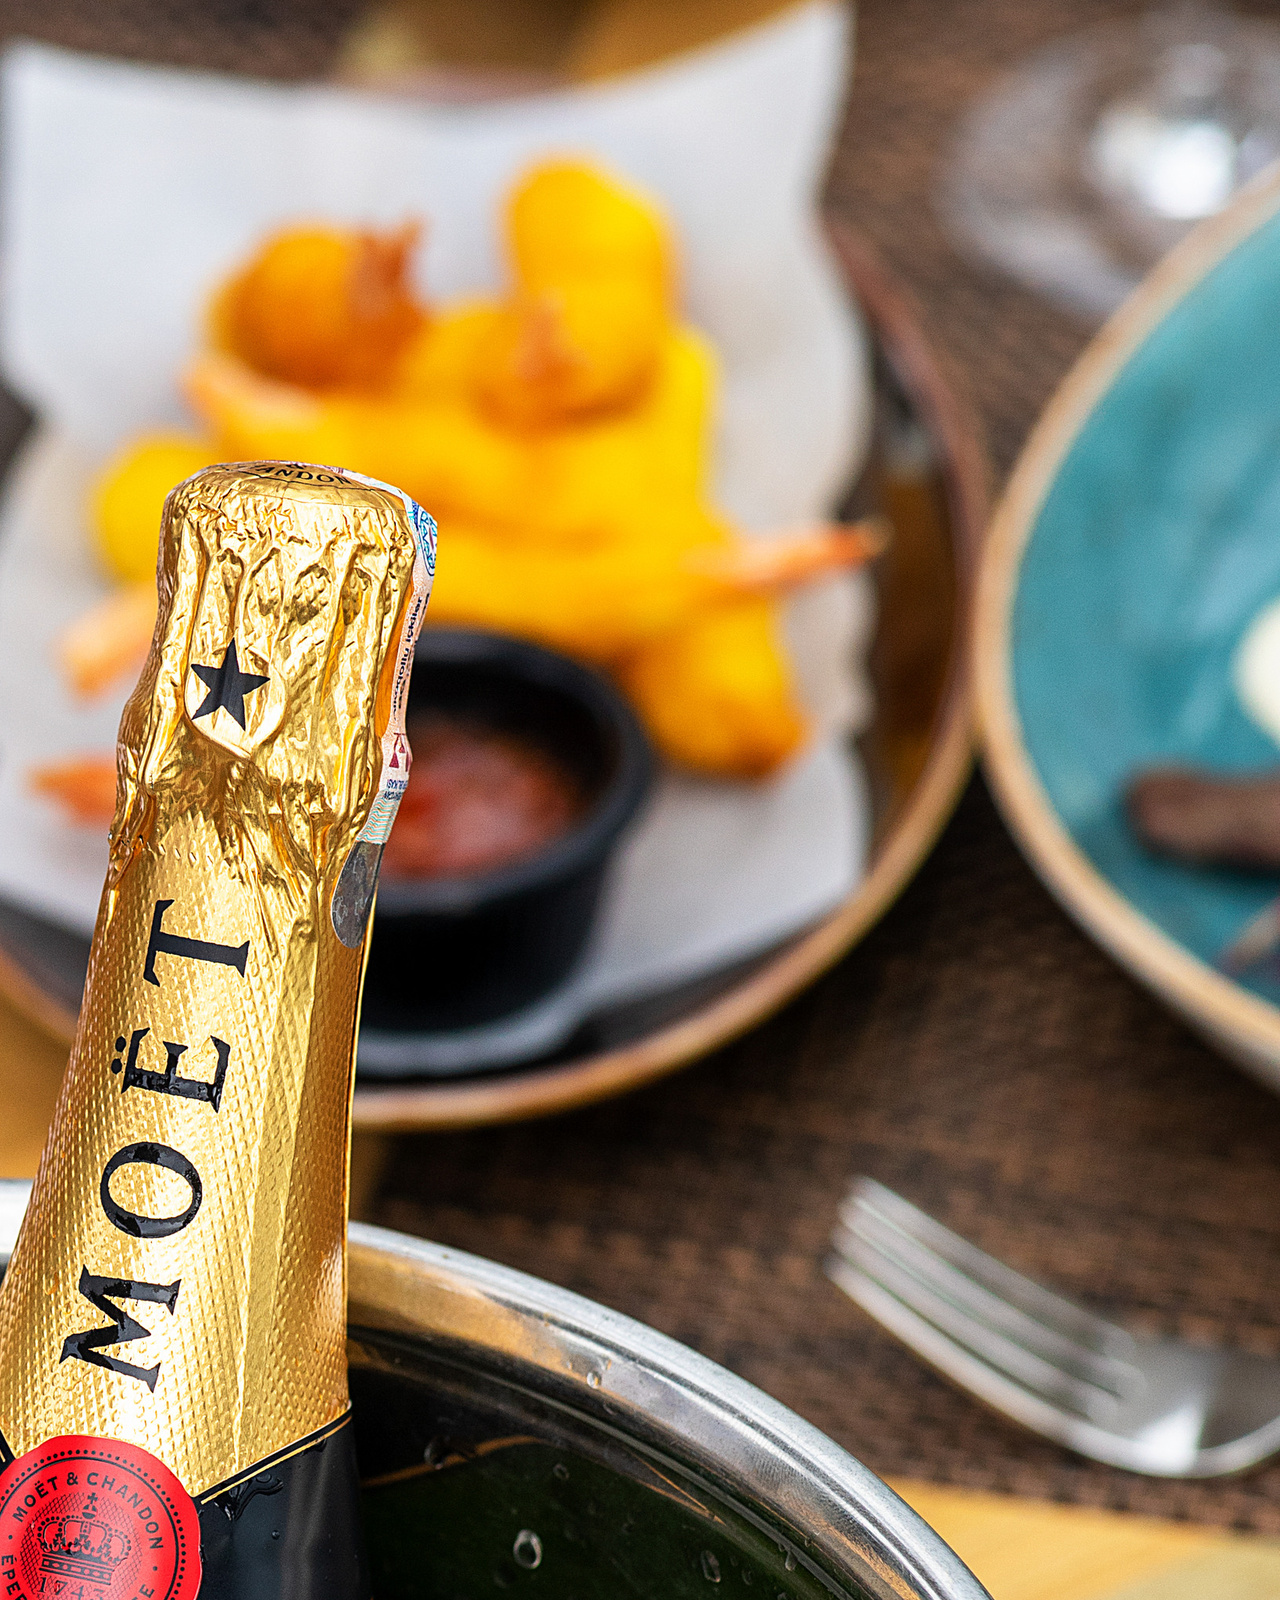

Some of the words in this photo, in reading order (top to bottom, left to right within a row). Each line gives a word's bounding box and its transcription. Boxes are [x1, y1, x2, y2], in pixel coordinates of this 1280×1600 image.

[60, 898, 251, 1391] MOËT
[12, 1475, 59, 1523] MOËT
[66, 1471, 79, 1487] &
[86, 1471, 164, 1550] CHANDON
